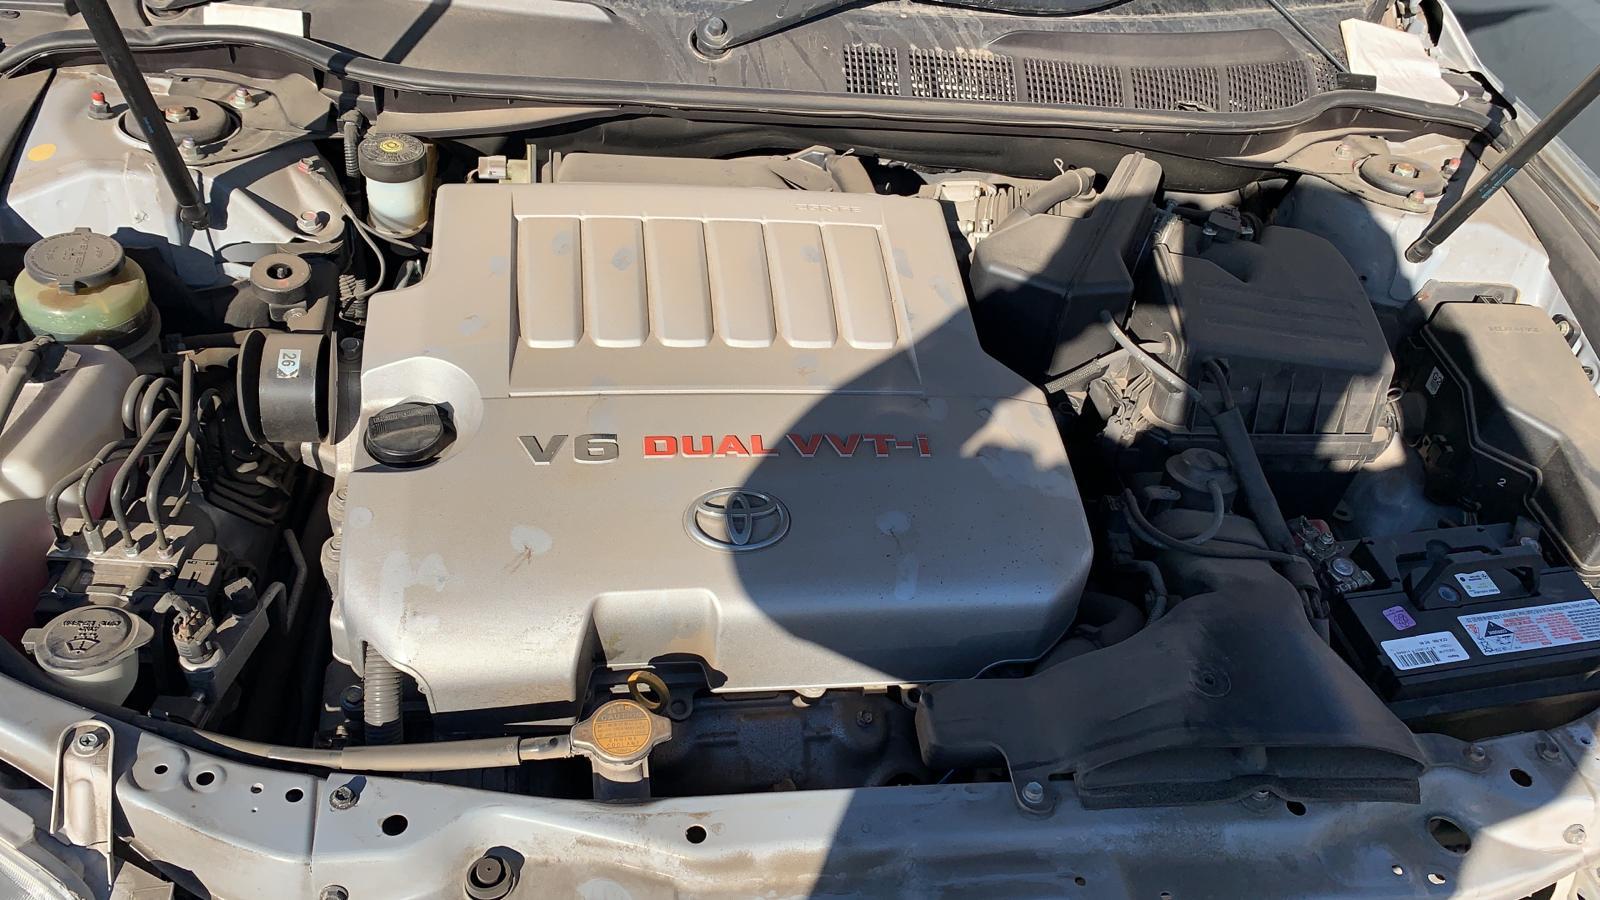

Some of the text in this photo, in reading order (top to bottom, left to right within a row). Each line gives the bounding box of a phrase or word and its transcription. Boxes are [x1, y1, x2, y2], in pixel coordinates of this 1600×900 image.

[281, 352, 298, 367] 26
[517, 433, 932, 466] V6 DUAL VVT-i
[1496, 477, 1507, 488] 2
